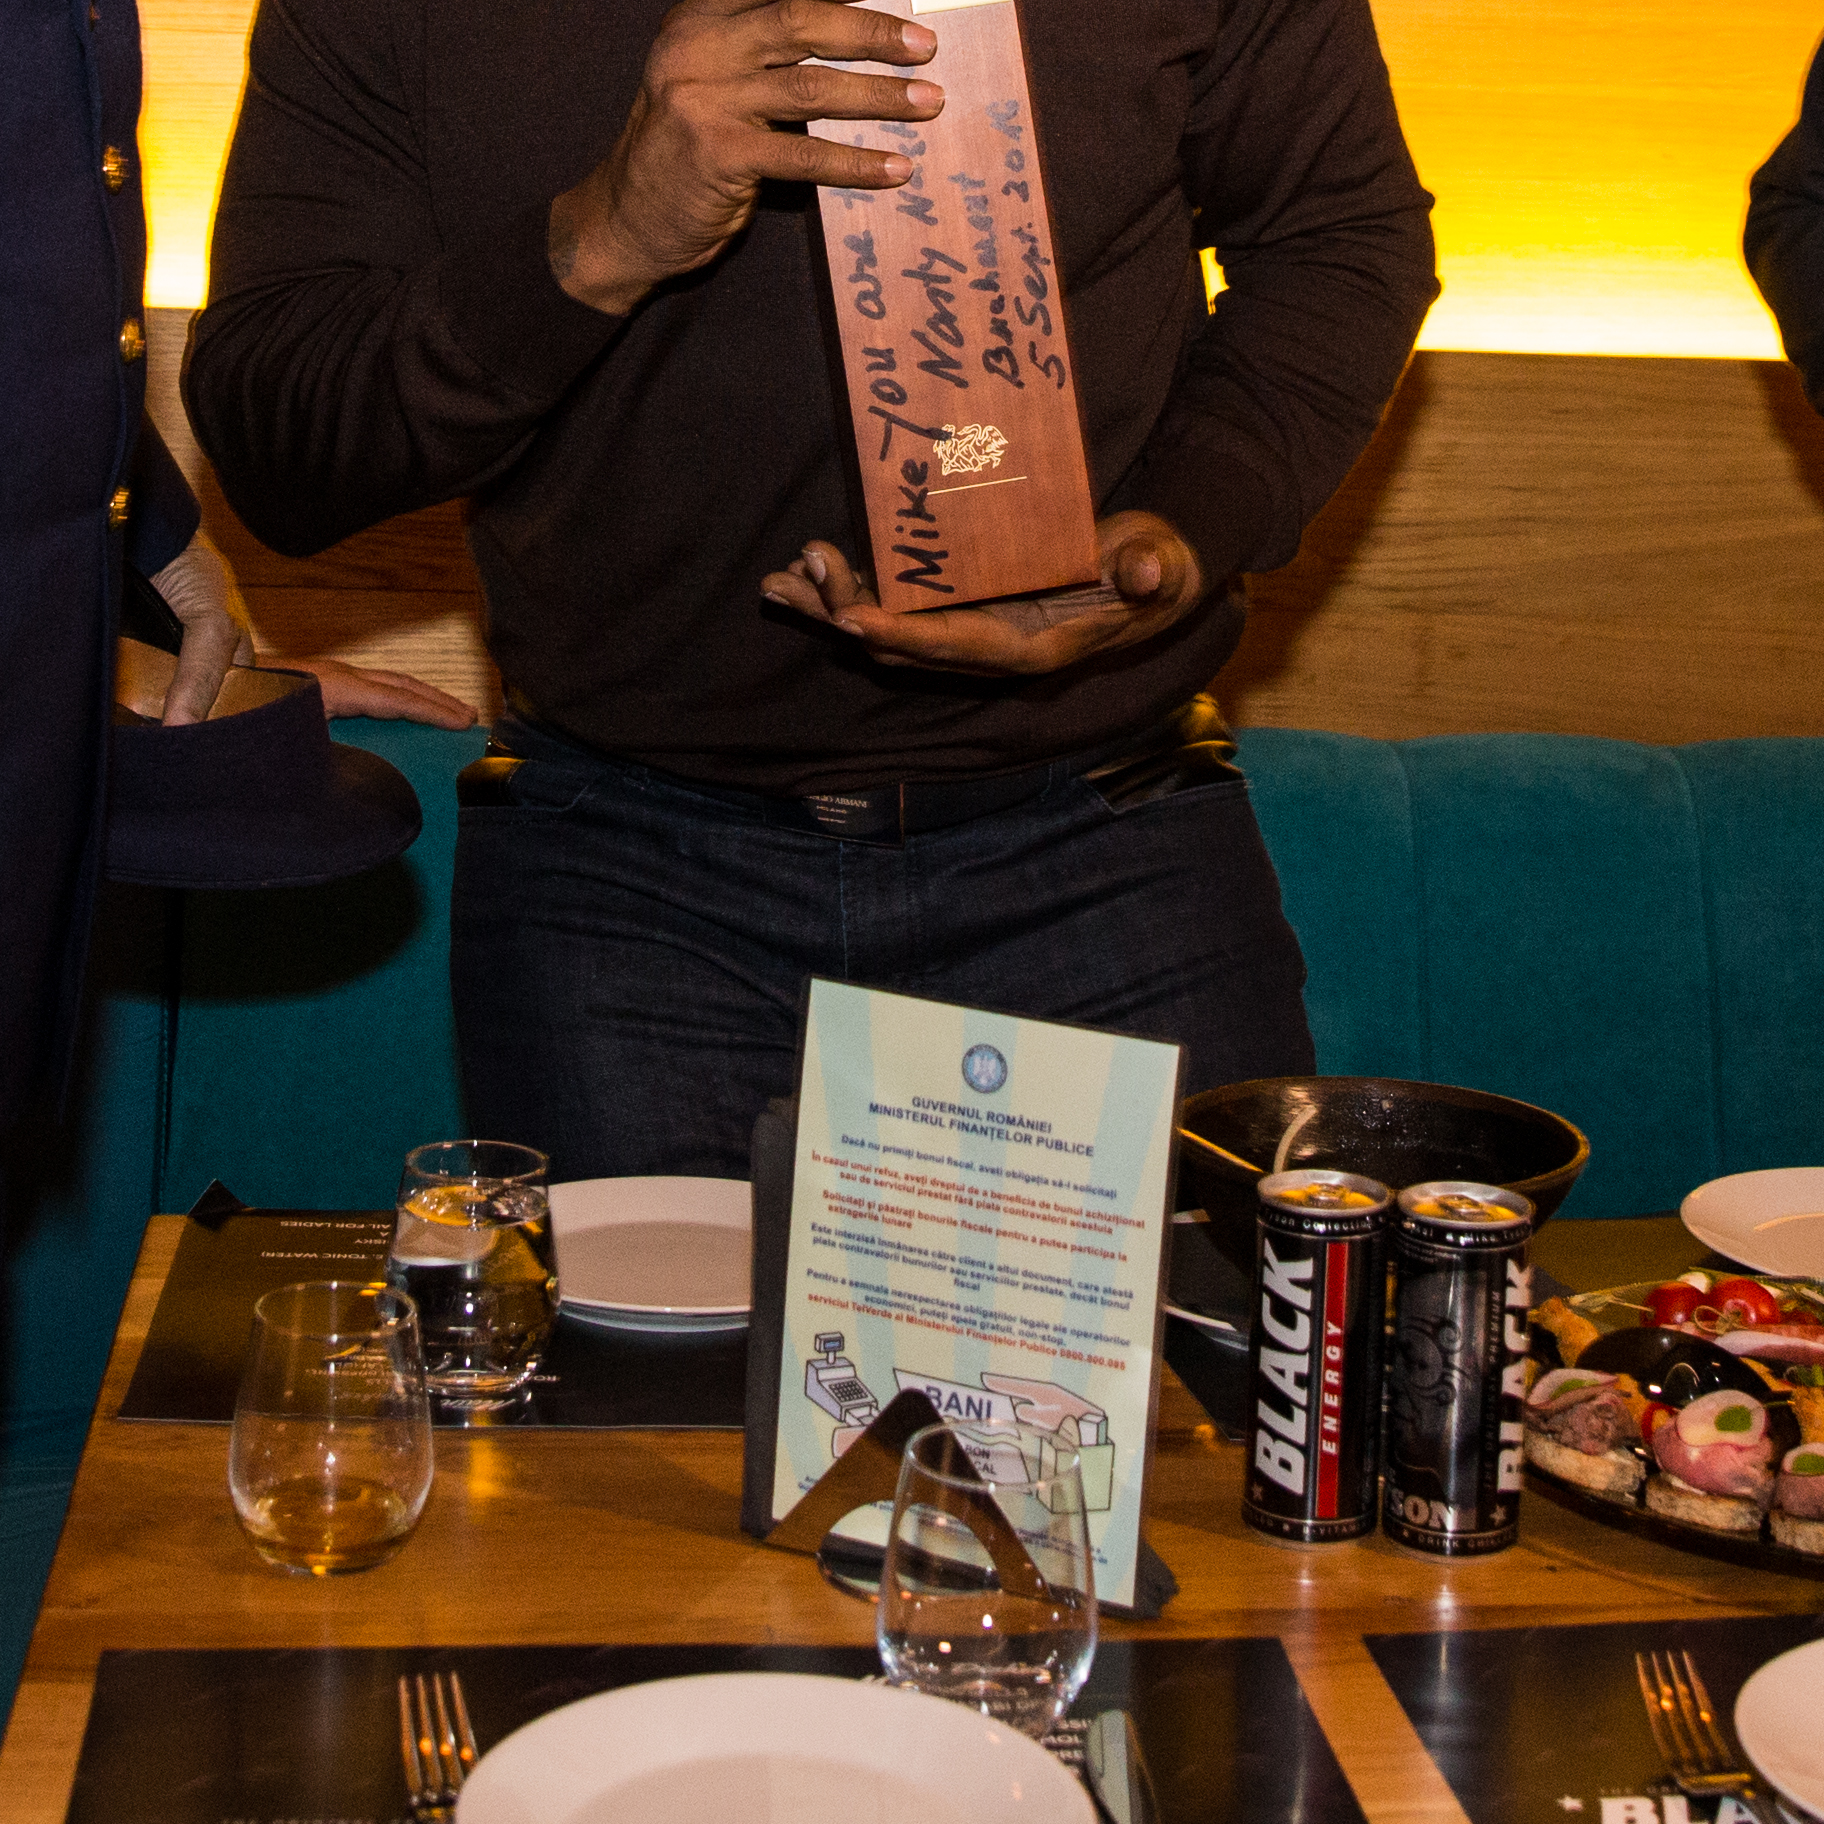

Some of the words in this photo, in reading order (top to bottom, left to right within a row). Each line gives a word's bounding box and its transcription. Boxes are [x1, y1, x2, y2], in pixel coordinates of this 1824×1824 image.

[841, 230, 889, 320] are
[1029, 342, 1067, 390] 5
[892, 459, 954, 594] Mike
[868, 1101, 945, 1128] MINISTERUL
[1035, 1134, 1094, 1158] PUBLICE
[911, 1095, 982, 1120] GUVERNUL
[986, 1107, 1052, 1134] ROMÂNIEI
[916, 1149, 944, 1164] bonul
[822, 1154, 849, 1168] cazul
[850, 1160, 872, 1173] unui
[930, 1176, 965, 1193] dreptul
[990, 1188, 1036, 1207] beneficia
[1053, 1201, 1083, 1217] bunul
[839, 1170, 857, 1182] sau
[873, 1176, 915, 1194] serviciul
[917, 1186, 952, 1203] prestat
[354, 1237, 389, 1245] ISKY
[881, 1213, 912, 1229] lunare
[917, 1209, 957, 1227] bonurile
[960, 1217, 993, 1234] fiscale
[995, 1226, 1029, 1244] pentru
[1039, 1235, 1068, 1252] putea
[1070, 1241, 1115, 1262] participa
[810, 1220, 832, 1235] Este
[1077, 1280, 1099, 1293] care
[901, 1253, 947, 1272] bunurilor
[949, 1265, 967, 1277] sau
[1099, 1296, 1130, 1312] bonul
[953, 1276, 980, 1291] fiscal
[806, 1266, 838, 1284] Pentru
[1019, 1315, 1050, 1332] legale
[1052, 1322, 1067, 1334] ale
[807, 1291, 849, 1310] serviciul
[905, 1312, 964, 1336] Ministerului
[1019, 1337, 1057, 1356] Publice
[1254, 1237, 1313, 1495] BLACK
[1321, 1321, 1343, 1455] ENERGY
[925, 1384, 993, 1420] BANI
